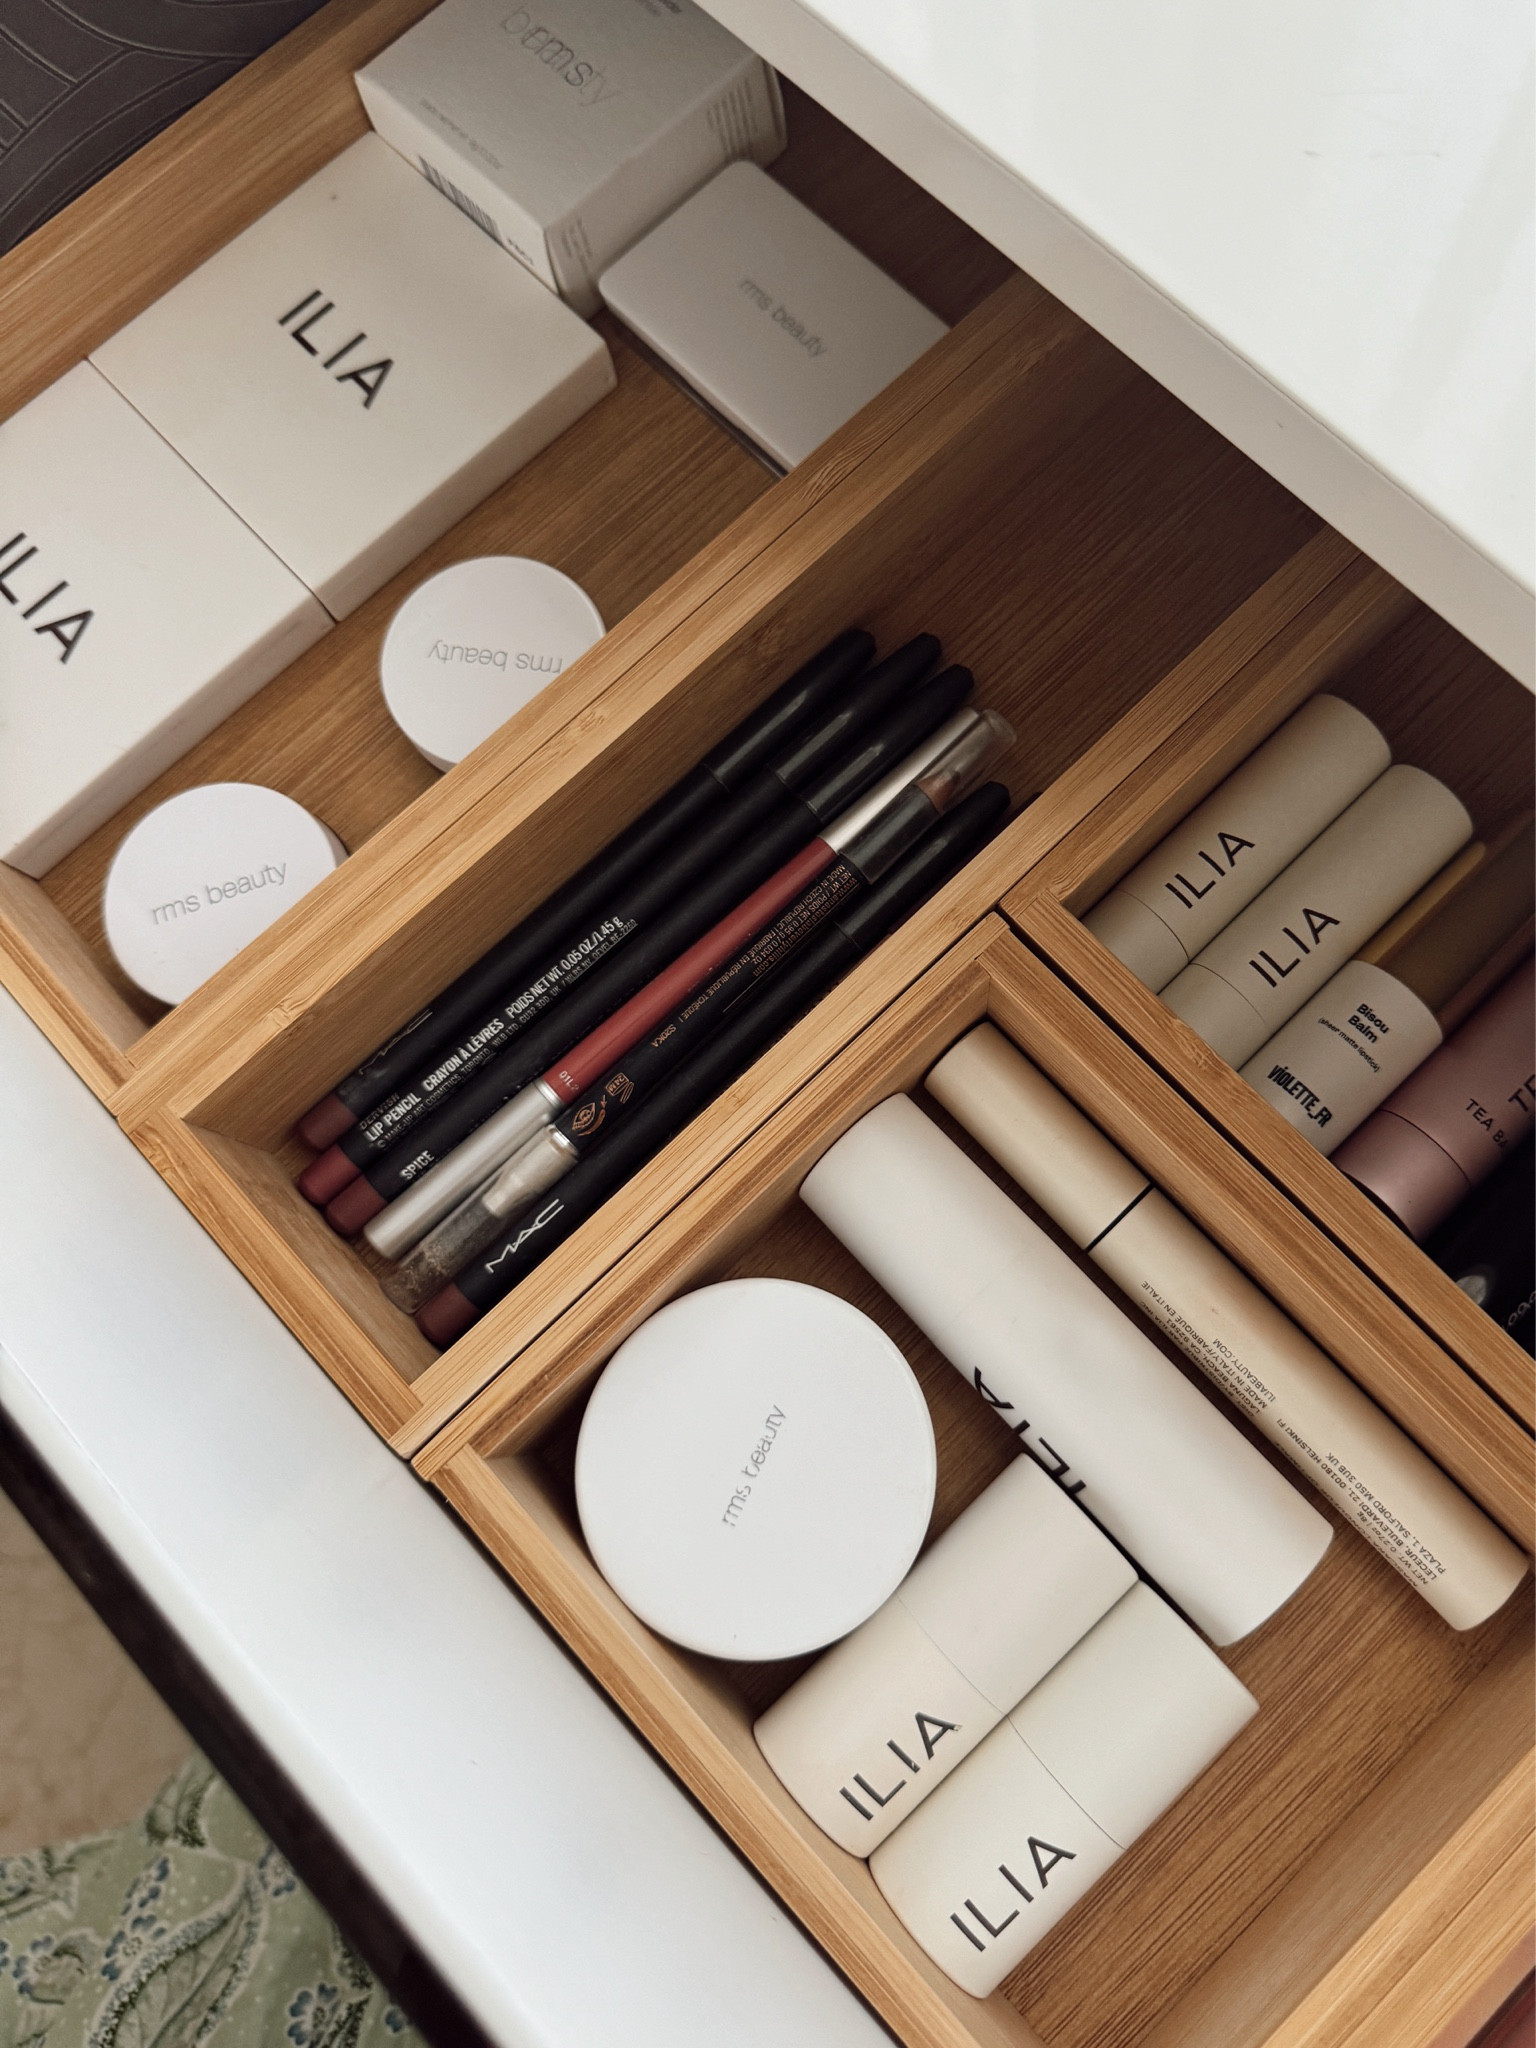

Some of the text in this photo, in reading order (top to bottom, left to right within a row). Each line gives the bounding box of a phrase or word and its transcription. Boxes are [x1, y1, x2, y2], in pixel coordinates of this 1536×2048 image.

[738, 278, 828, 358] rms beauty
[279, 289, 394, 410] ILIA
[429, 639, 564, 675] rms beauty
[820, 879, 829, 888] IN
[826, 863, 845, 882] MADE
[837, 869, 851, 884] NET
[1165, 831, 1255, 909] ILIA
[152, 862, 288, 926] rms beauty
[801, 884, 823, 906] CZECH
[807, 892, 827, 913] POIDS
[775, 902, 805, 929] REPUBLIC
[783, 918, 799, 935] 0.95
[796, 908, 811, 924] NET
[738, 953, 750, 965] EN
[759, 938, 778, 958] 0.034
[1249, 906, 1340, 988] ILIA
[365, 1120, 387, 1141] LIP
[382, 1090, 421, 1126] PENCIL
[421, 1052, 463, 1093] CRAYON
[464, 1016, 505, 1053] LÈVRES
[504, 989, 535, 1019] POIDS
[529, 976, 551, 998] NET
[545, 963, 565, 984] WT.
[559, 948, 583, 971] 0.05
[610, 915, 624, 928] g
[1347, 1014, 1379, 1043] Balm
[1356, 1002, 1389, 1034] Bisou
[1317, 1016, 1380, 1073] (sheer matte lipstick)
[412, 1103, 427, 1117] ART
[1465, 1098, 1494, 1131] TEA
[399, 1149, 434, 1181] SPICE
[1140, 1280, 1267, 1409] MADE IN ITALY/FABRIQUÉ EN ITALIE
[1189, 1342, 1201, 1354] CA
[1200, 1353, 1229, 1382] BEACH,
[1212, 1338, 1276, 1401] ILIABEAUTY.COM
[1228, 1381, 1260, 1414] LAGUNA
[1276, 1417, 1286, 1427] FI
[1284, 1426, 1321, 1463] HELSINKI
[1324, 1451, 1339, 1466] UK
[722, 1404, 786, 1526] rms beauty
[1319, 1461, 1346, 1489] 00180
[1337, 1464, 1356, 1483] 3UB
[1345, 1487, 1360, 1502] 21,
[1354, 1480, 1374, 1501] M50
[1358, 1500, 1403, 1546] BULEVARDI
[1372, 1498, 1411, 1538] SALFORD
[1417, 1544, 1446, 1574] PLAZA
[1412, 1568, 1428, 1584] NET
[838, 1711, 963, 1822] ILIA
[949, 1835, 1077, 1953] ILIA
